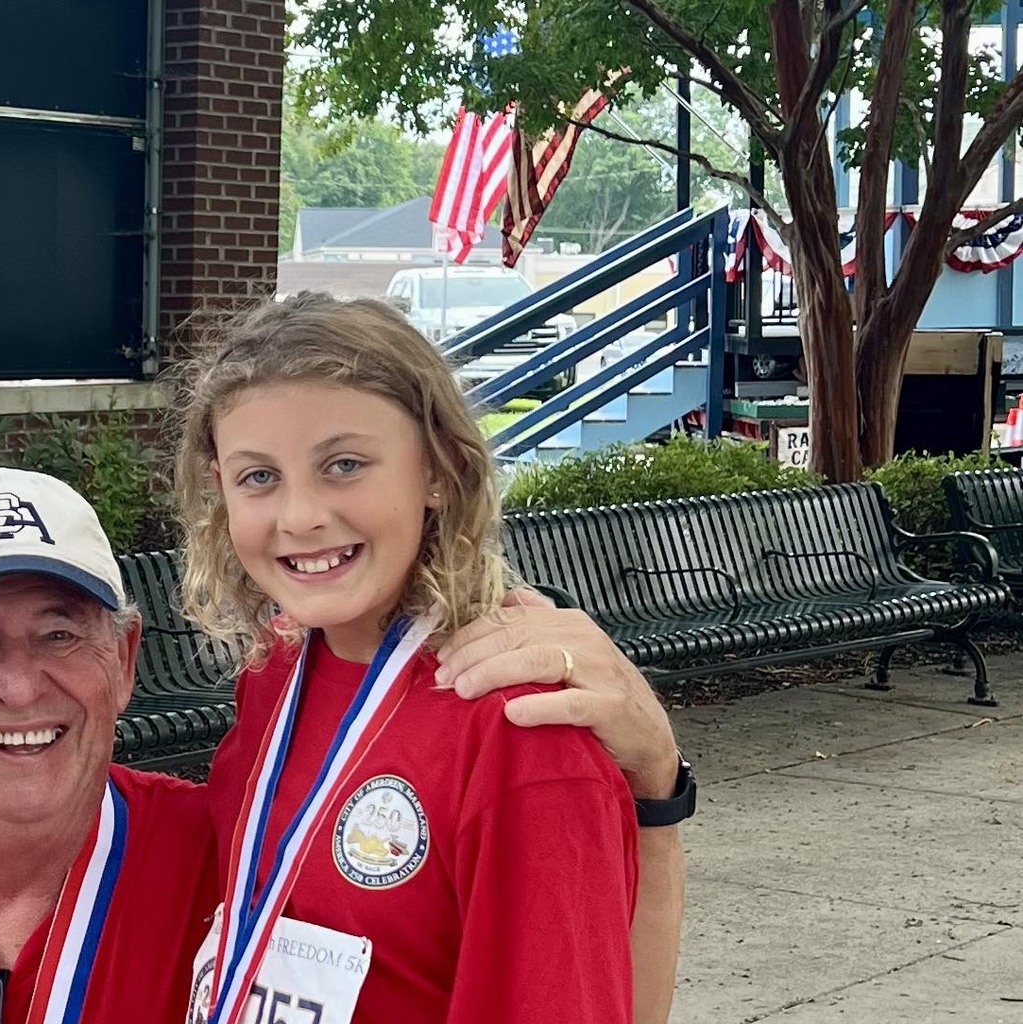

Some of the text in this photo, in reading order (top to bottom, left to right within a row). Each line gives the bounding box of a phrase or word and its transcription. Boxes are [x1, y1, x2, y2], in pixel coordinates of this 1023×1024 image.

[355, 789, 365, 801] OF
[361, 803, 402, 832] 250
[365, 852, 422, 885] CELEBRATION
[277, 936, 343, 967] FREEDOM
[344, 955, 365, 975] 5K
